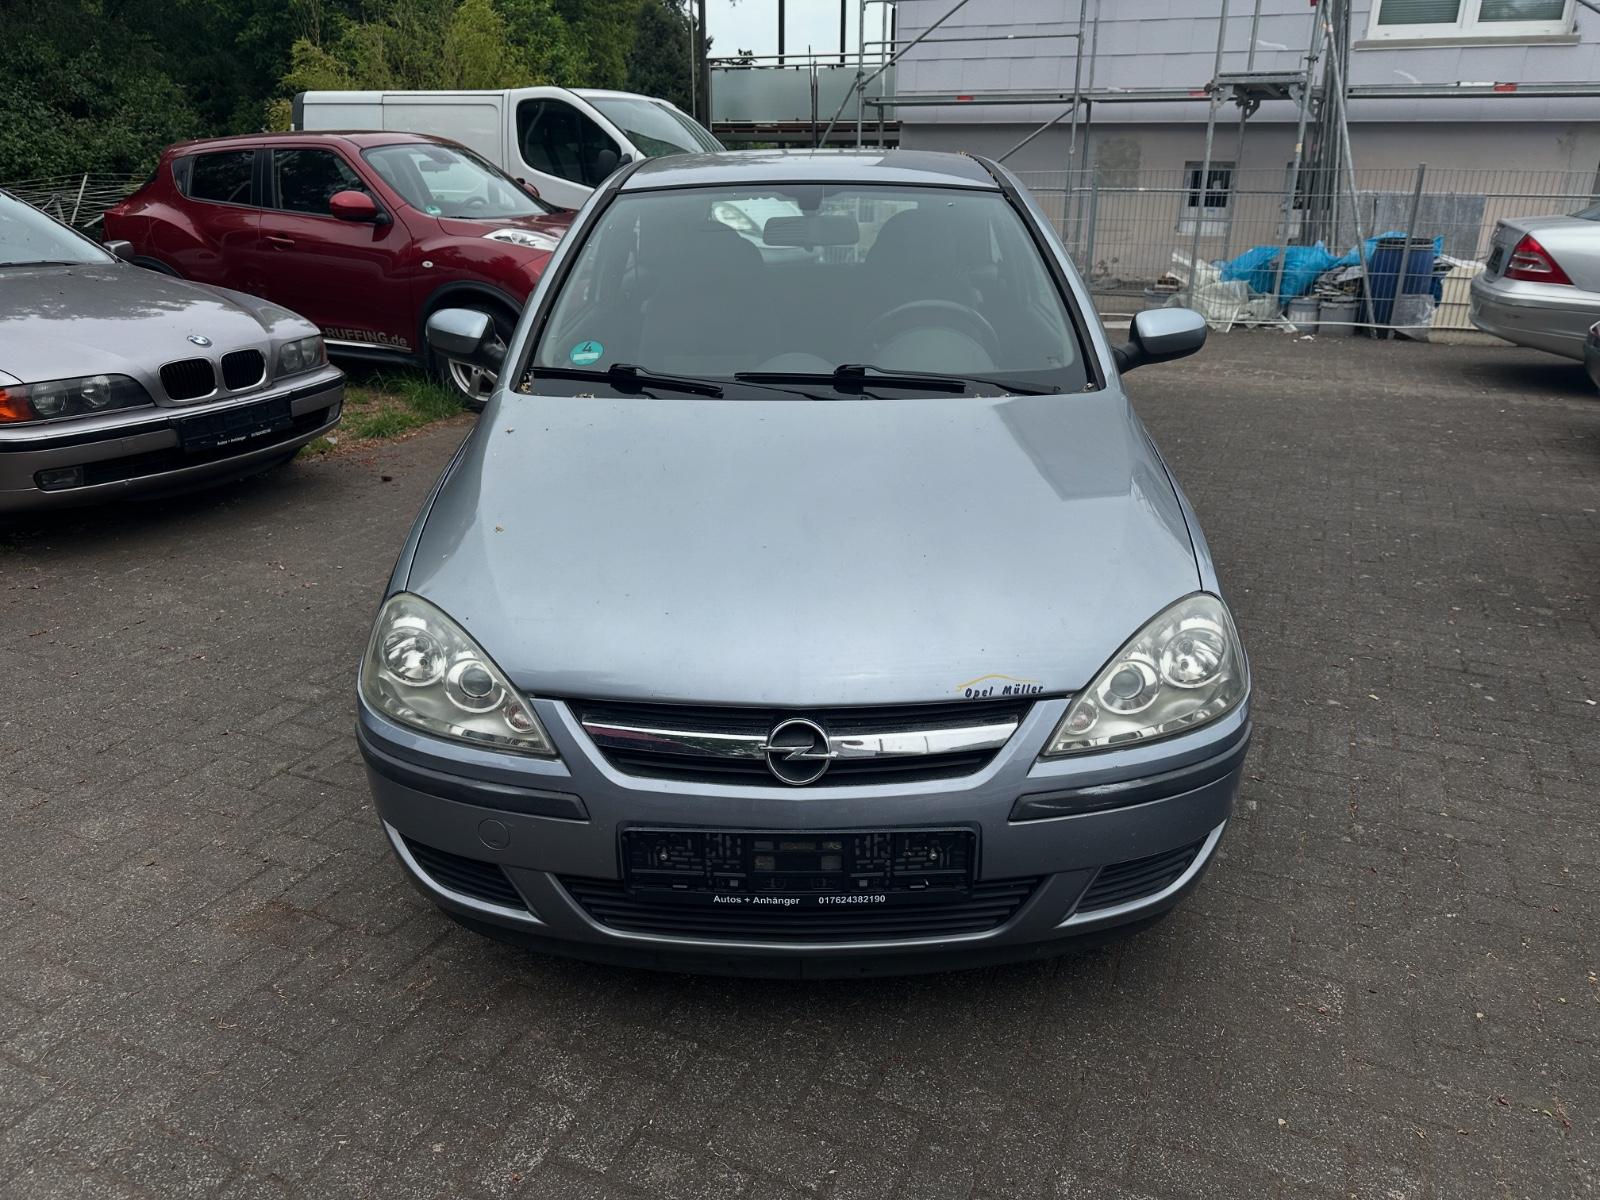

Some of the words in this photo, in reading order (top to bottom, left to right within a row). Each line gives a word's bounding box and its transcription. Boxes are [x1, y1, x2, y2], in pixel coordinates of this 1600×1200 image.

[582, 342, 592, 352] 4
[965, 686, 994, 699] Opel
[1002, 684, 1043, 695] Müller
[713, 895, 742, 903] Autos
[753, 896, 800, 906] Anhänger
[818, 895, 886, 904] 017624382190
